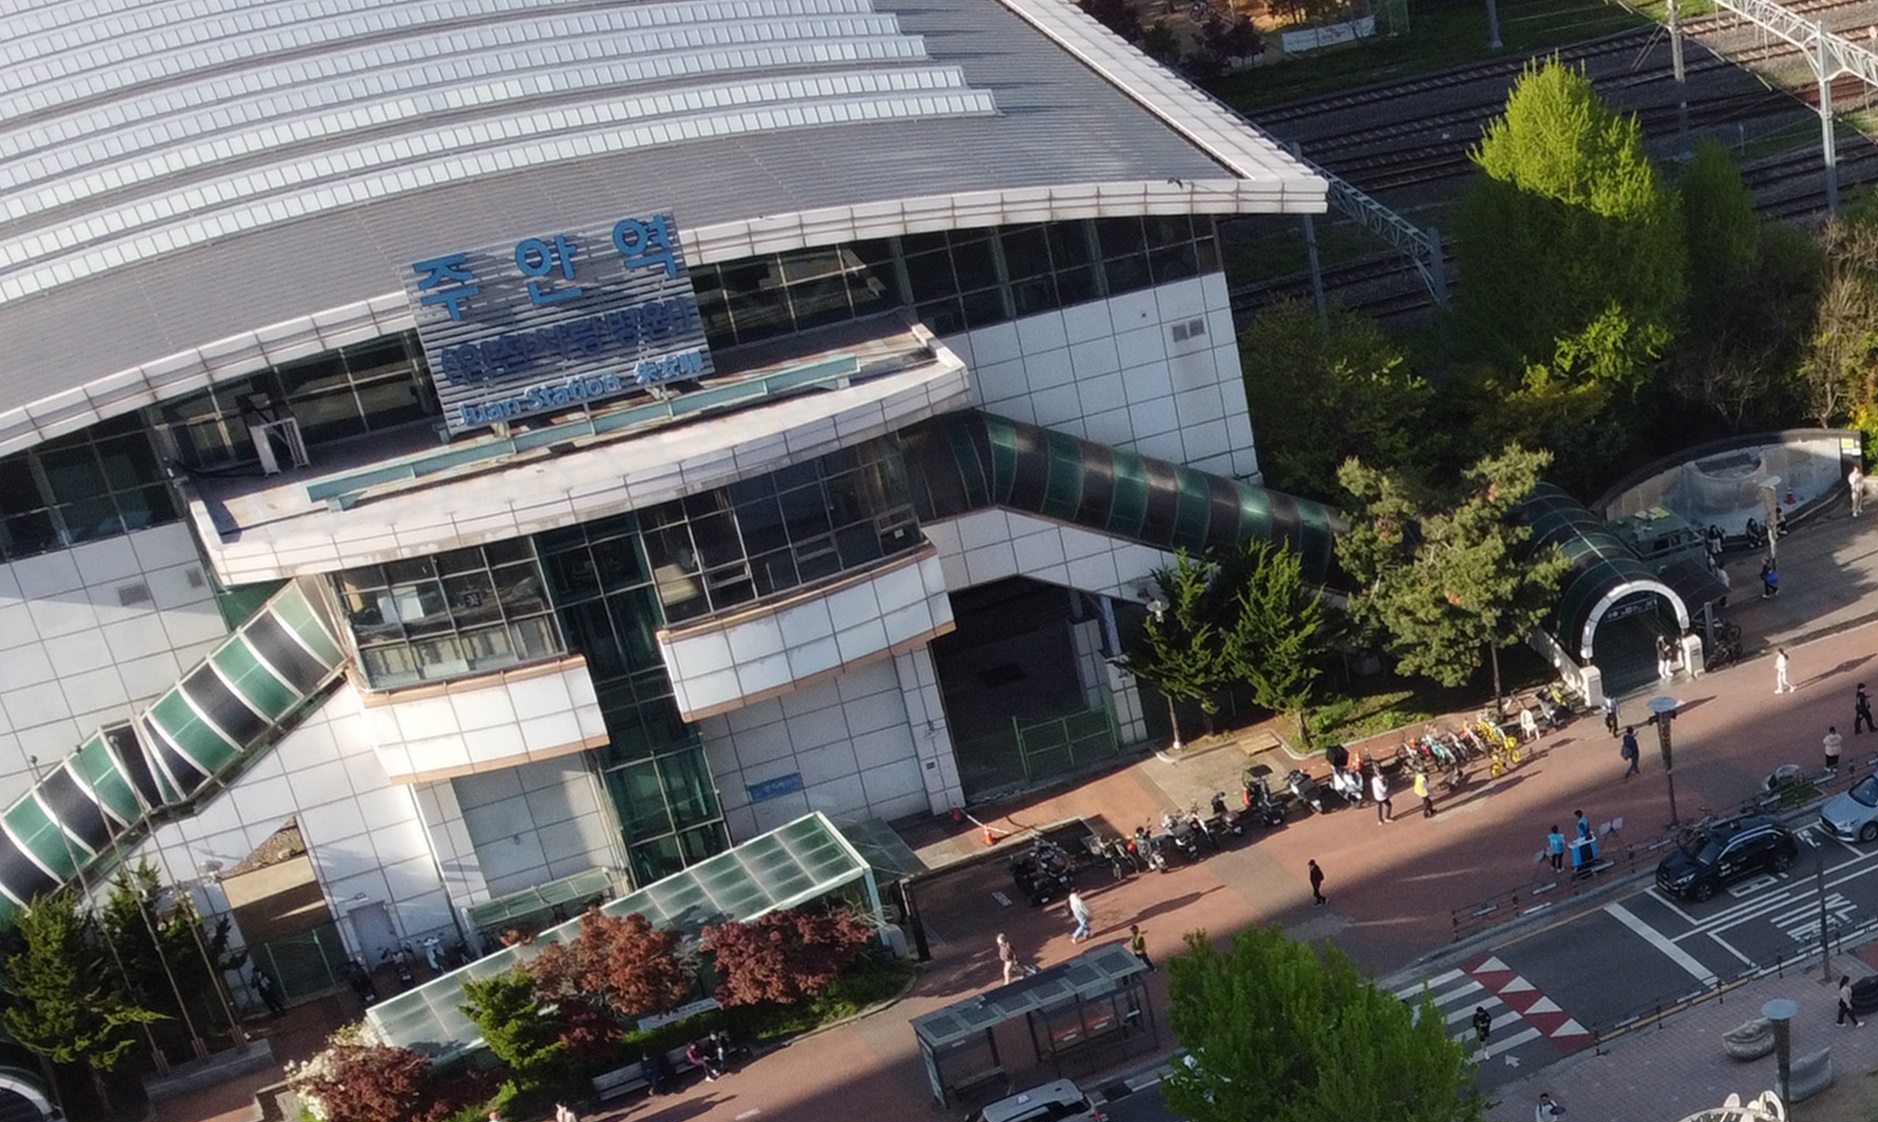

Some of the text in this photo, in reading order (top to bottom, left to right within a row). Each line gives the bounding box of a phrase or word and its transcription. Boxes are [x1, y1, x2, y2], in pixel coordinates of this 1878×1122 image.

[412, 214, 677, 320] 주안역
[459, 373, 622, 426] Juan Station
